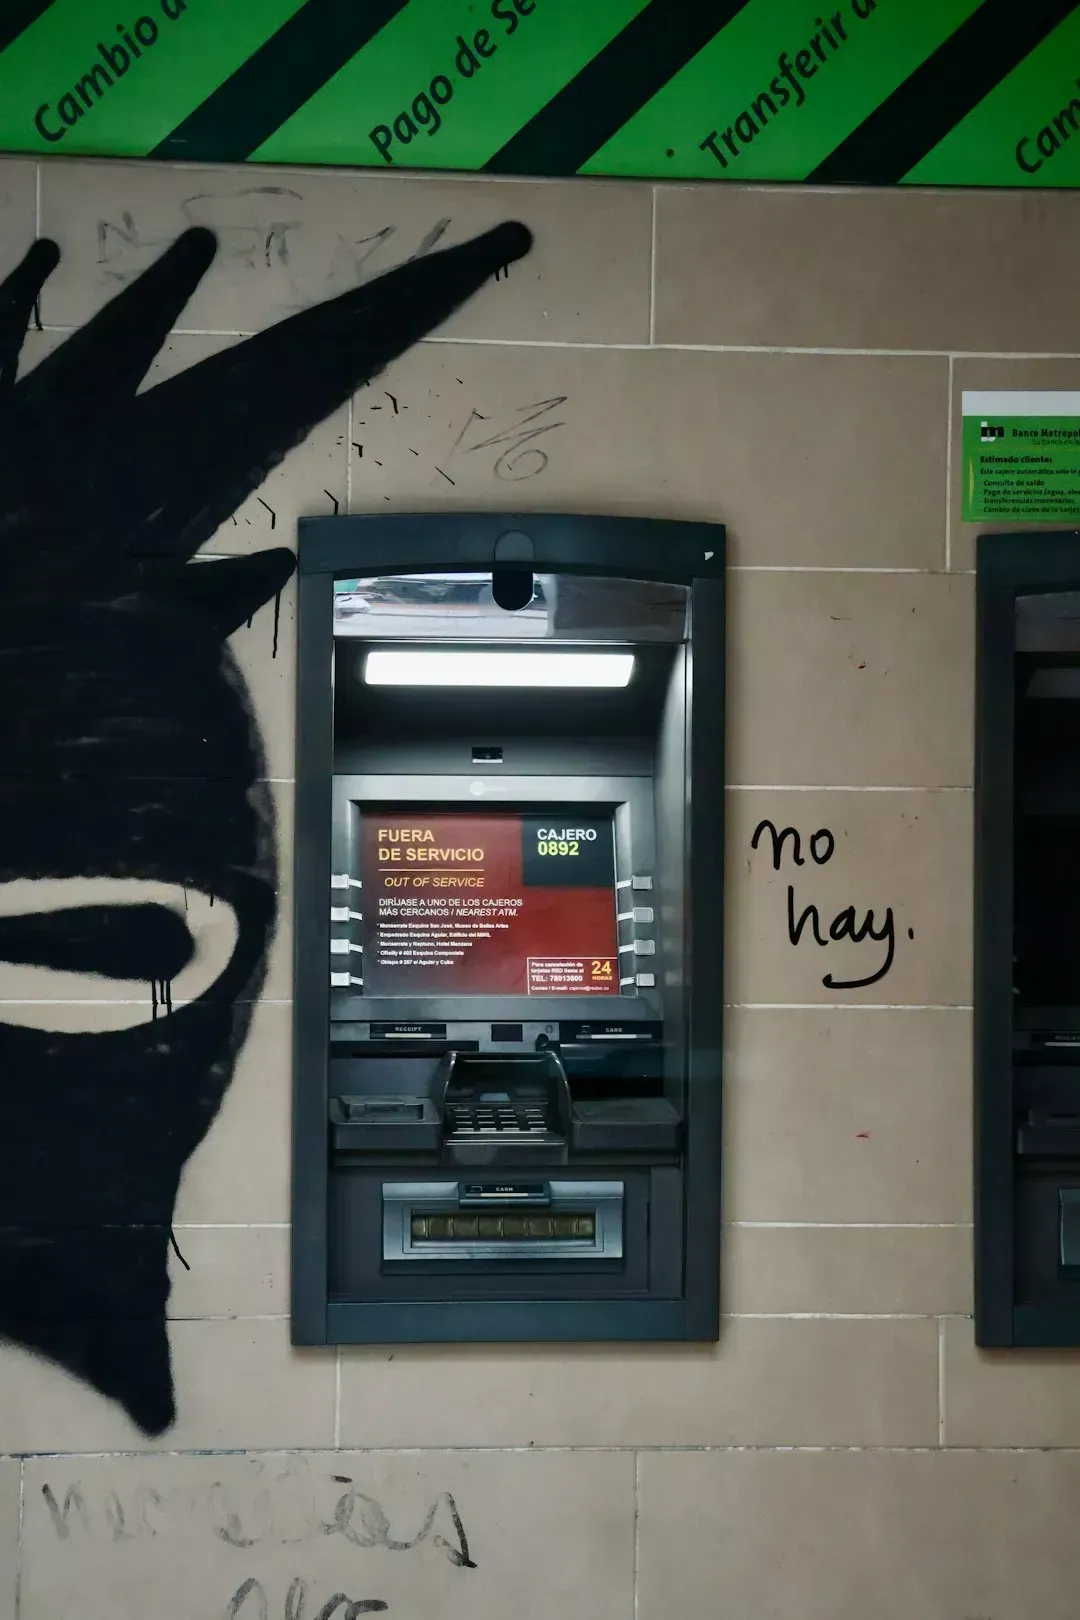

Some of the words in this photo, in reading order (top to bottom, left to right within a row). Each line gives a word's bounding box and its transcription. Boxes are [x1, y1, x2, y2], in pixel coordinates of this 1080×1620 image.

[35, 17, 158, 142] Cambio
[368, 74, 453, 163] Pago
[455, 30, 497, 79] de
[699, 19, 849, 169] Transferir
[1015, 78, 1080, 174] Cam
[1012, 429, 1039, 438] Banco
[378, 830, 435, 842] FUERA
[537, 829, 597, 841] CAJERO
[537, 842, 579, 856] 0892
[751, 819, 836, 871] no
[378, 848, 401, 861] DE
[405, 848, 485, 862] SERVICIO
[384, 877, 410, 887] OUT
[413, 877, 430, 887] OF
[432, 877, 485, 887] SERVICE
[379, 897, 418, 907] DIRÍJASE
[419, 899, 426, 907] A
[427, 899, 447, 907] UNO
[448, 899, 461, 907] DE
[462, 899, 480, 907] LOS
[482, 899, 523, 907] CAJEROS
[379, 907, 398, 916] MÁS
[400, 908, 449, 916] CERCANOS
[456, 908, 497, 916] NEAREST
[498, 908, 519, 916] ATM.
[787, 884, 915, 989] hay.
[591, 960, 612, 975] 24
